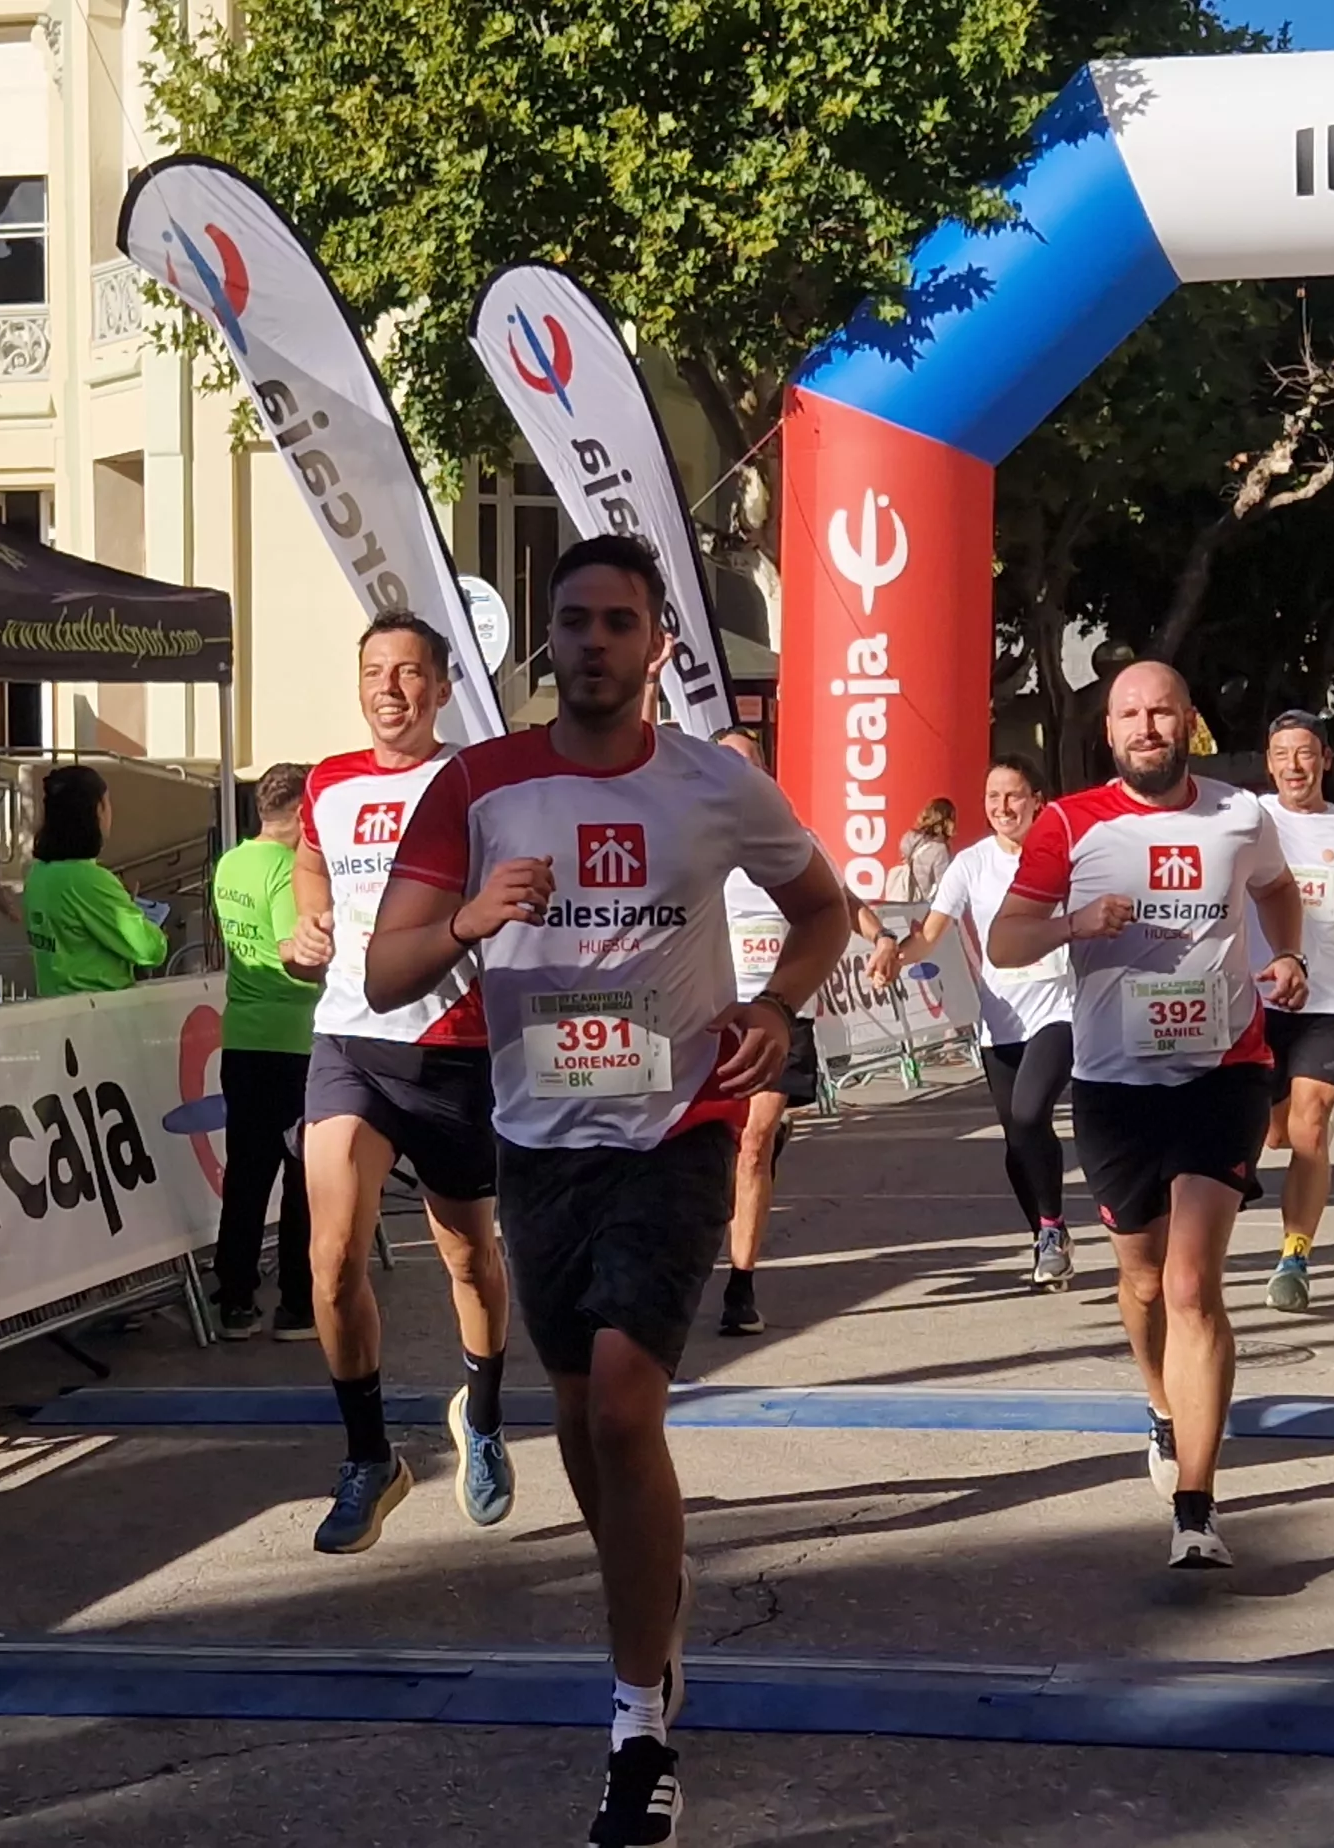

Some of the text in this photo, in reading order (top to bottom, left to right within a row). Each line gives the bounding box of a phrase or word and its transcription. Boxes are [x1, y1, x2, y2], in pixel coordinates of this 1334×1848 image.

[546, 899, 688, 928] alesianos
[1134, 899, 1230, 921] lesianos
[578, 938, 641, 955] HUESCA
[742, 938, 780, 954] 540
[1148, 1000, 1207, 1026] 392
[556, 1018, 632, 1052] 391
[1154, 1027, 1204, 1039] DANIEL
[554, 1053, 640, 1070] LORENZO
[568, 1072, 594, 1087] 8K
